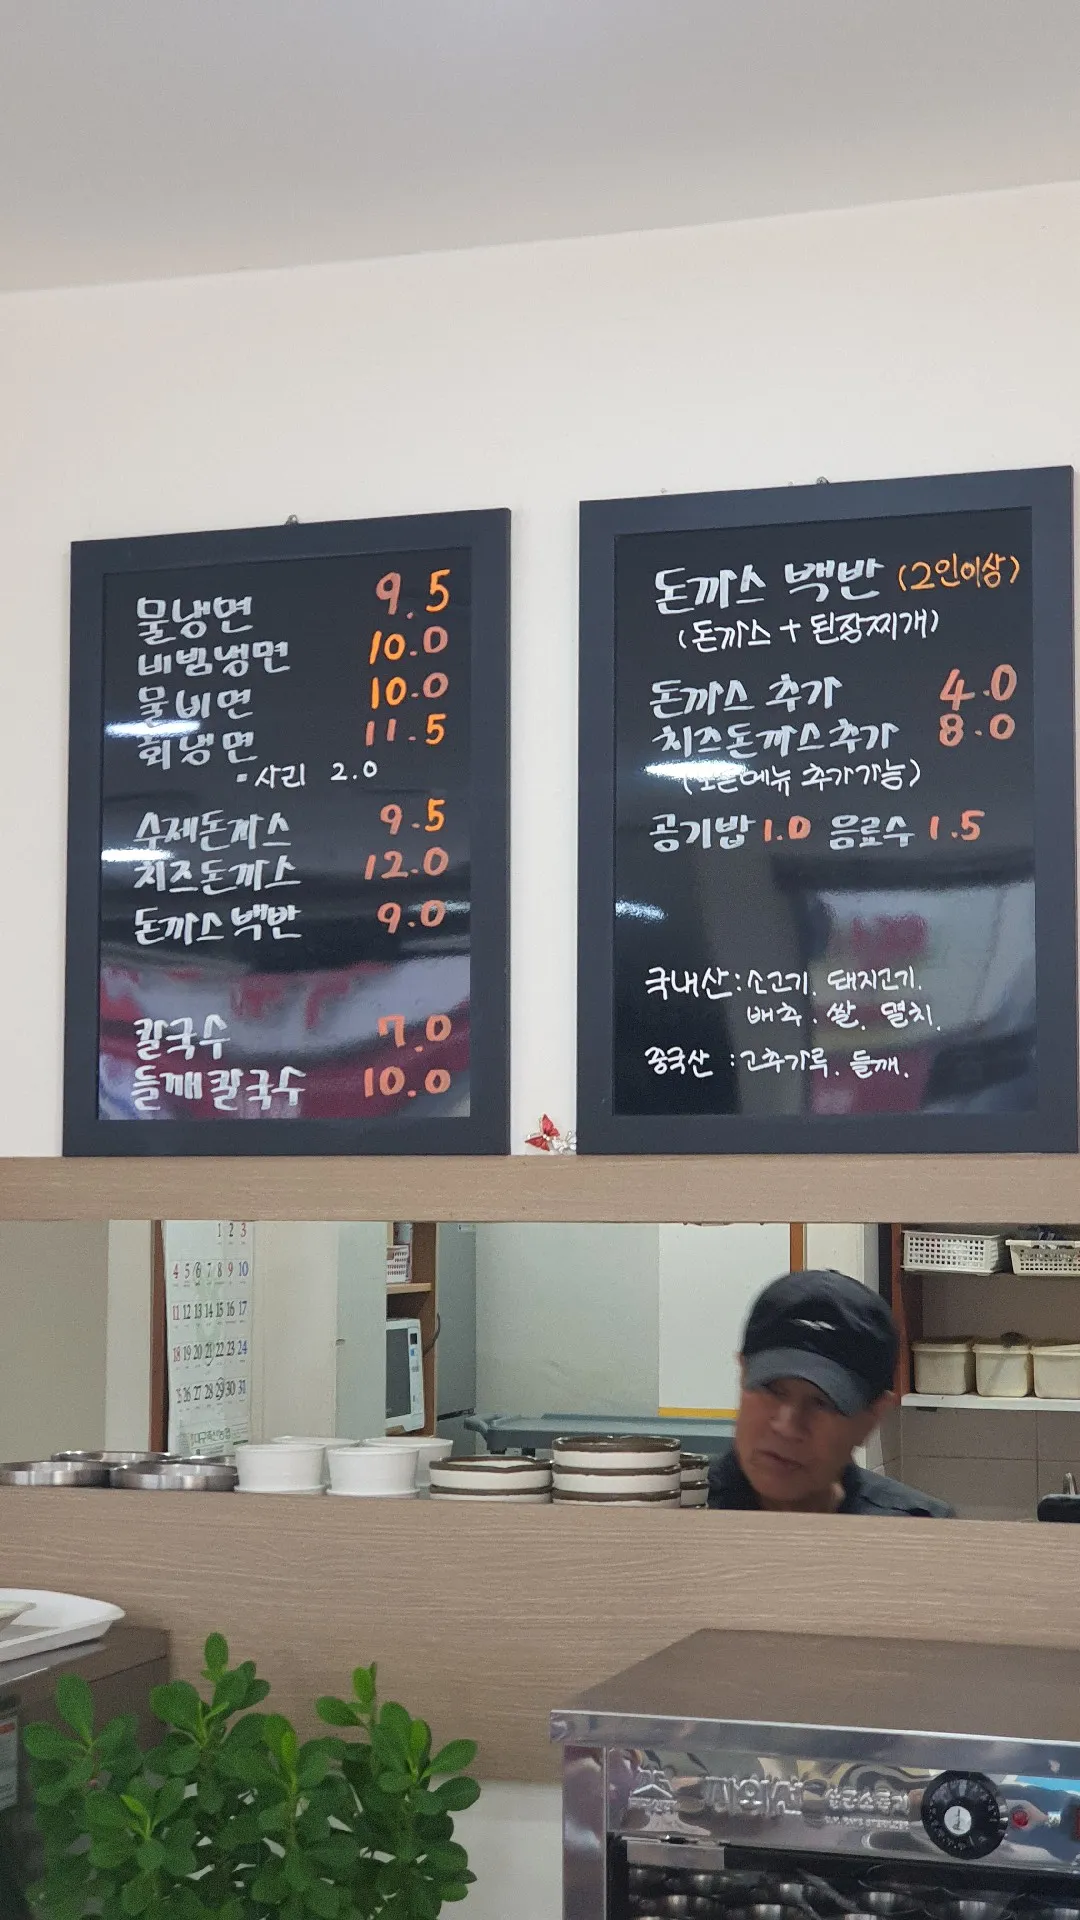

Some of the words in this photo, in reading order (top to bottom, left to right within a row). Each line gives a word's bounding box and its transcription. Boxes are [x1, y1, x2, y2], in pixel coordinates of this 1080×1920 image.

[655, 564, 766, 614] 돈까스
[785, 558, 884, 602] 백반
[899, 553, 1019, 591] (2인이상)
[137, 596, 253, 648] 물냉면
[376, 569, 450, 619] 9.5
[679, 619, 771, 652] (돈까스
[811, 609, 938, 644] 된장찌개)
[138, 637, 290, 677] 비빔냉면
[369, 626, 448, 664] 10.0
[371, 673, 448, 709] 10.0
[650, 680, 755, 718] 돈까스
[766, 673, 842, 712] 추가
[940, 664, 1017, 711] 4.0
[137, 731, 258, 769] 회냉면
[366, 713, 446, 746] 11.5
[940, 714, 1015, 746] 8.0
[331, 761, 377, 780] 2.0
[133, 810, 291, 851] 수제돈까스
[381, 798, 445, 834] 9.5
[649, 814, 756, 852] 공기밥
[764, 816, 811, 841] 1.0
[830, 815, 915, 850] 음료수
[930, 810, 985, 840] 1.5
[134, 853, 301, 895] 치즈돈까스
[365, 847, 448, 880] 12.0
[377, 900, 448, 933] 9.0
[134, 1015, 230, 1060] 칼국수
[379, 1016, 451, 1052] 7.0
[364, 1066, 450, 1097] 10.0
[217, 1223, 221, 1237] 1
[229, 1223, 233, 1237] 2
[241, 1223, 246, 1237] 3
[173, 1263, 178, 1279] 4
[185, 1263, 190, 1279] 5
[196, 1262, 201, 1278] 6
[207, 1263, 211, 1277] 7
[217, 1262, 222, 1277] 8
[228, 1262, 233, 1277] 9
[239, 1261, 249, 1276] 10
[173, 1305, 180, 1320] 11
[183, 1304, 191, 1319] 12
[194, 1303, 202, 1319] 13
[205, 1303, 213, 1318] 14
[216, 1302, 223, 1317] 15
[227, 1301, 235, 1316] 16
[239, 1301, 247, 1315] 17
[183, 1345, 191, 1360] 19
[194, 1344, 202, 1360] 20
[216, 1342, 224, 1357] 22
[227, 1341, 235, 1356] 23
[238, 1340, 247, 1355] 24
[194, 1385, 201, 1400] 27
[205, 1383, 213, 1399] 28
[216, 1382, 224, 1400] 29
[225, 1381, 236, 1397] 30
[238, 1380, 246, 1395] 31
